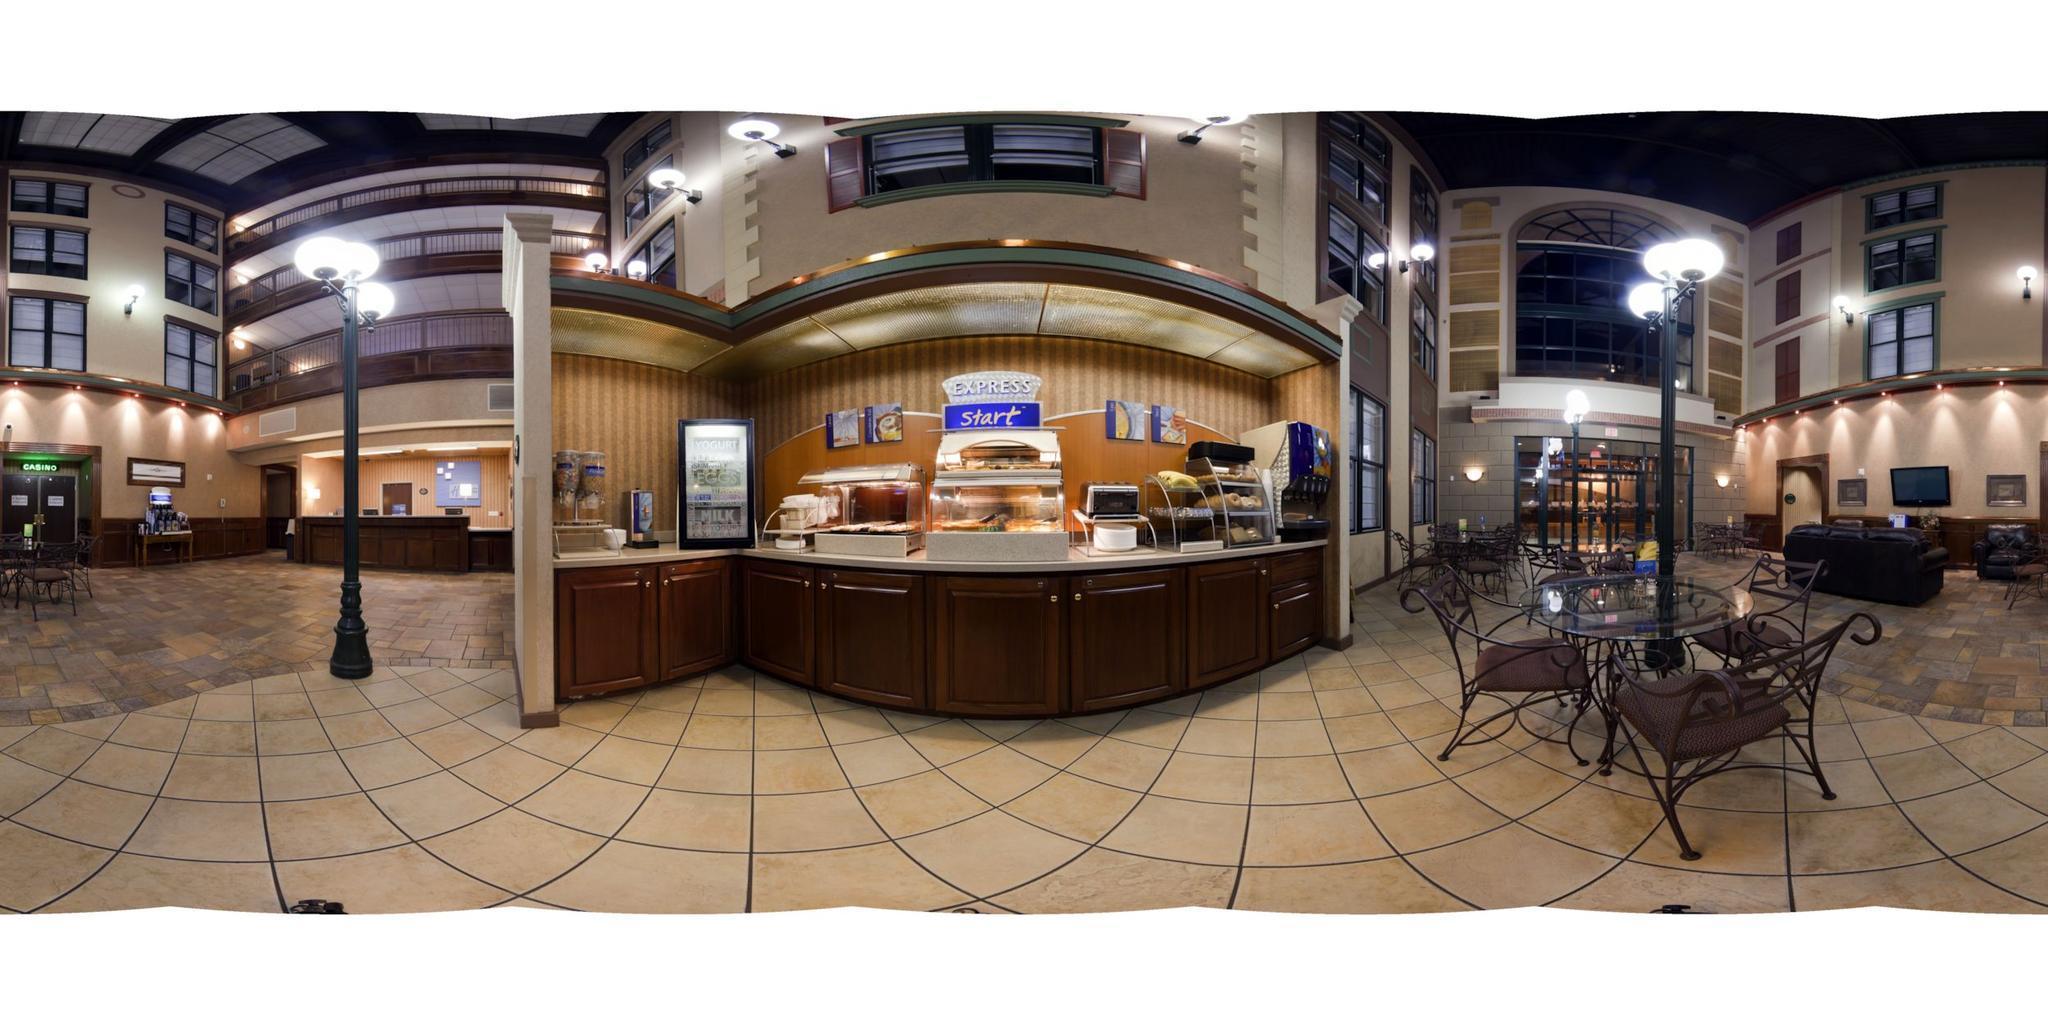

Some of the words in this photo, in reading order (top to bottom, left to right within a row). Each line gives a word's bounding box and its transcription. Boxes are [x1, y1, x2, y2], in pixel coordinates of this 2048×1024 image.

[953, 380, 1032, 396] EXPRESS
[960, 406, 1021, 426] start
[695, 439, 738, 449] YOGURT
[697, 471, 738, 484] EGGS
[701, 509, 735, 522] MILK
